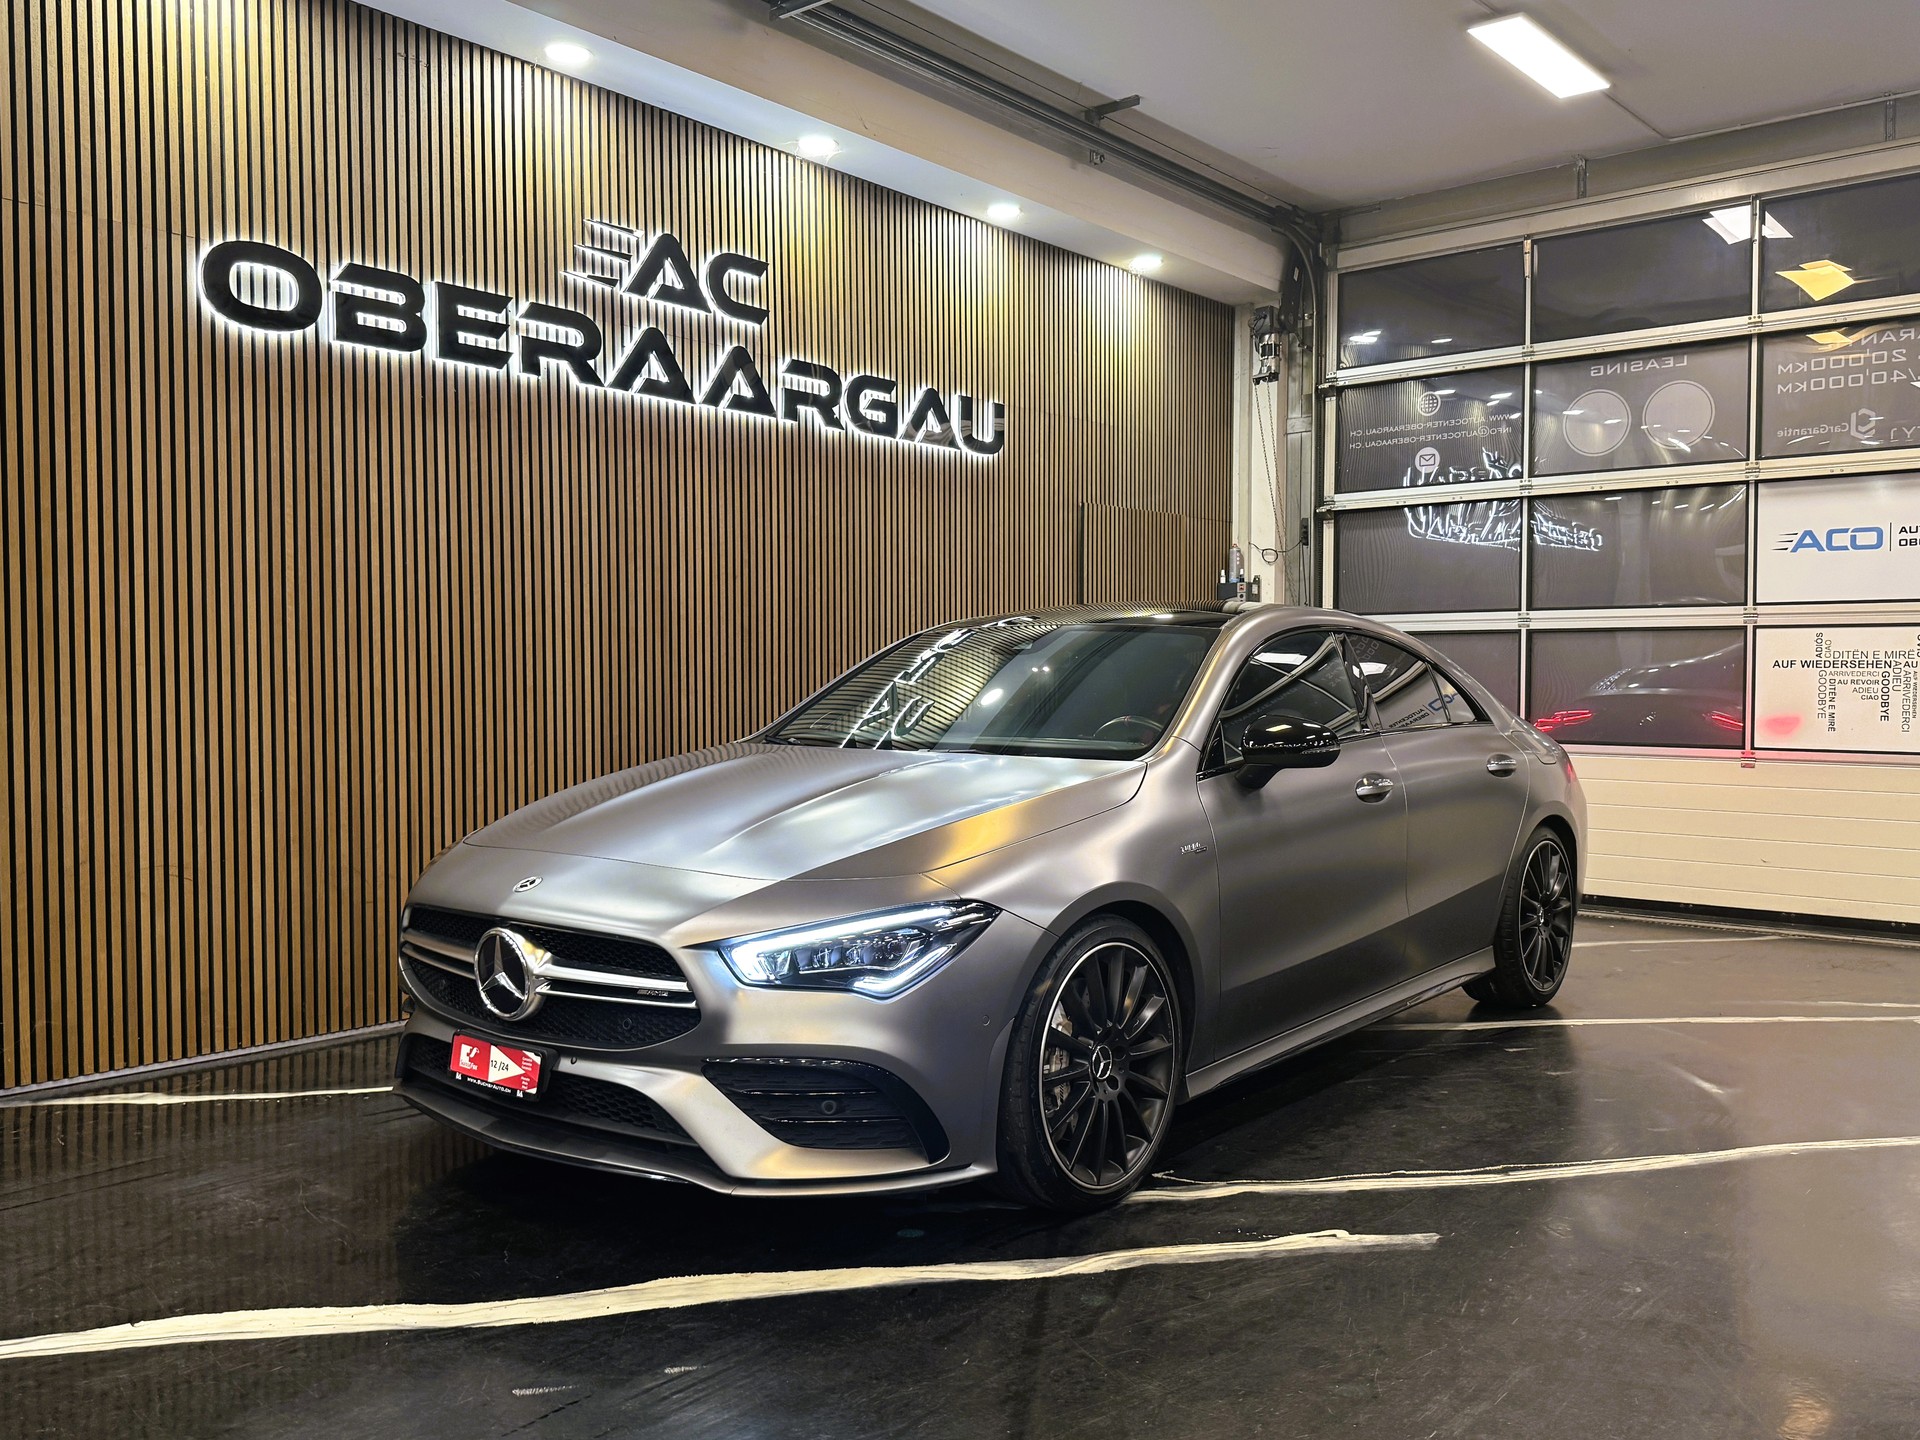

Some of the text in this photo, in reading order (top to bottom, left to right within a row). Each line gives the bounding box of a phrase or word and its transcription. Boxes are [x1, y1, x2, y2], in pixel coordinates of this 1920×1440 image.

[203, 239, 1005, 454] OBERAARGAU
[1789, 526, 1884, 553] ACO
[1898, 525, 1920, 535] AU
[1824, 639, 1832, 659] CIAO
[1872, 650, 1880, 659] E
[1772, 659, 1892, 669] AUF WIEDERSEHEN
[1891, 660, 1902, 692] ADIEU
[1817, 669, 1827, 719] GOODBYE
[1880, 671, 1890, 722] GOODBYE
[1901, 669, 1911, 733] ARRIVEDERCI
